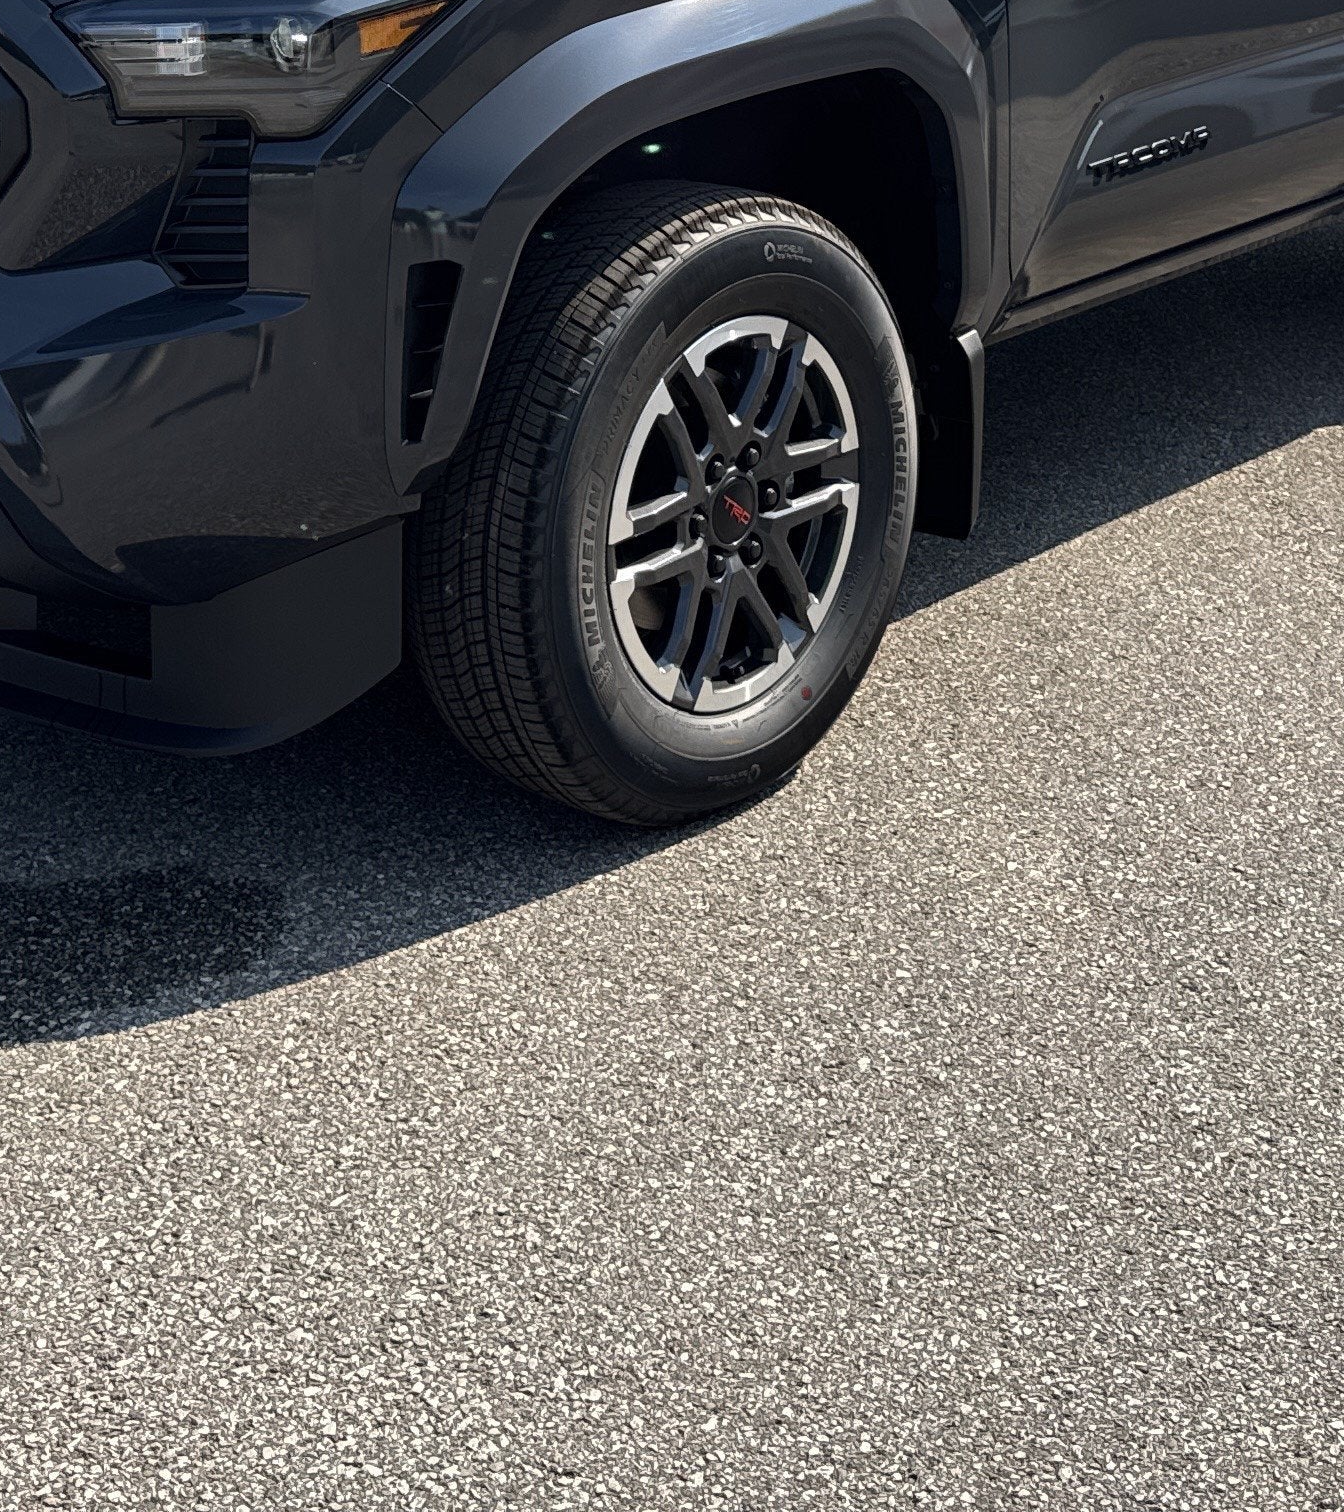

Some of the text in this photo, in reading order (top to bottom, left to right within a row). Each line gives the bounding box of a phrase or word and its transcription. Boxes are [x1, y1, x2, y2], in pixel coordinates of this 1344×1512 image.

[1086, 126, 1209, 186] TACOMA
[723, 494, 751, 525] TRD
[889, 400, 908, 543] MICHELIN
[581, 481, 603, 648] MICHELIN
